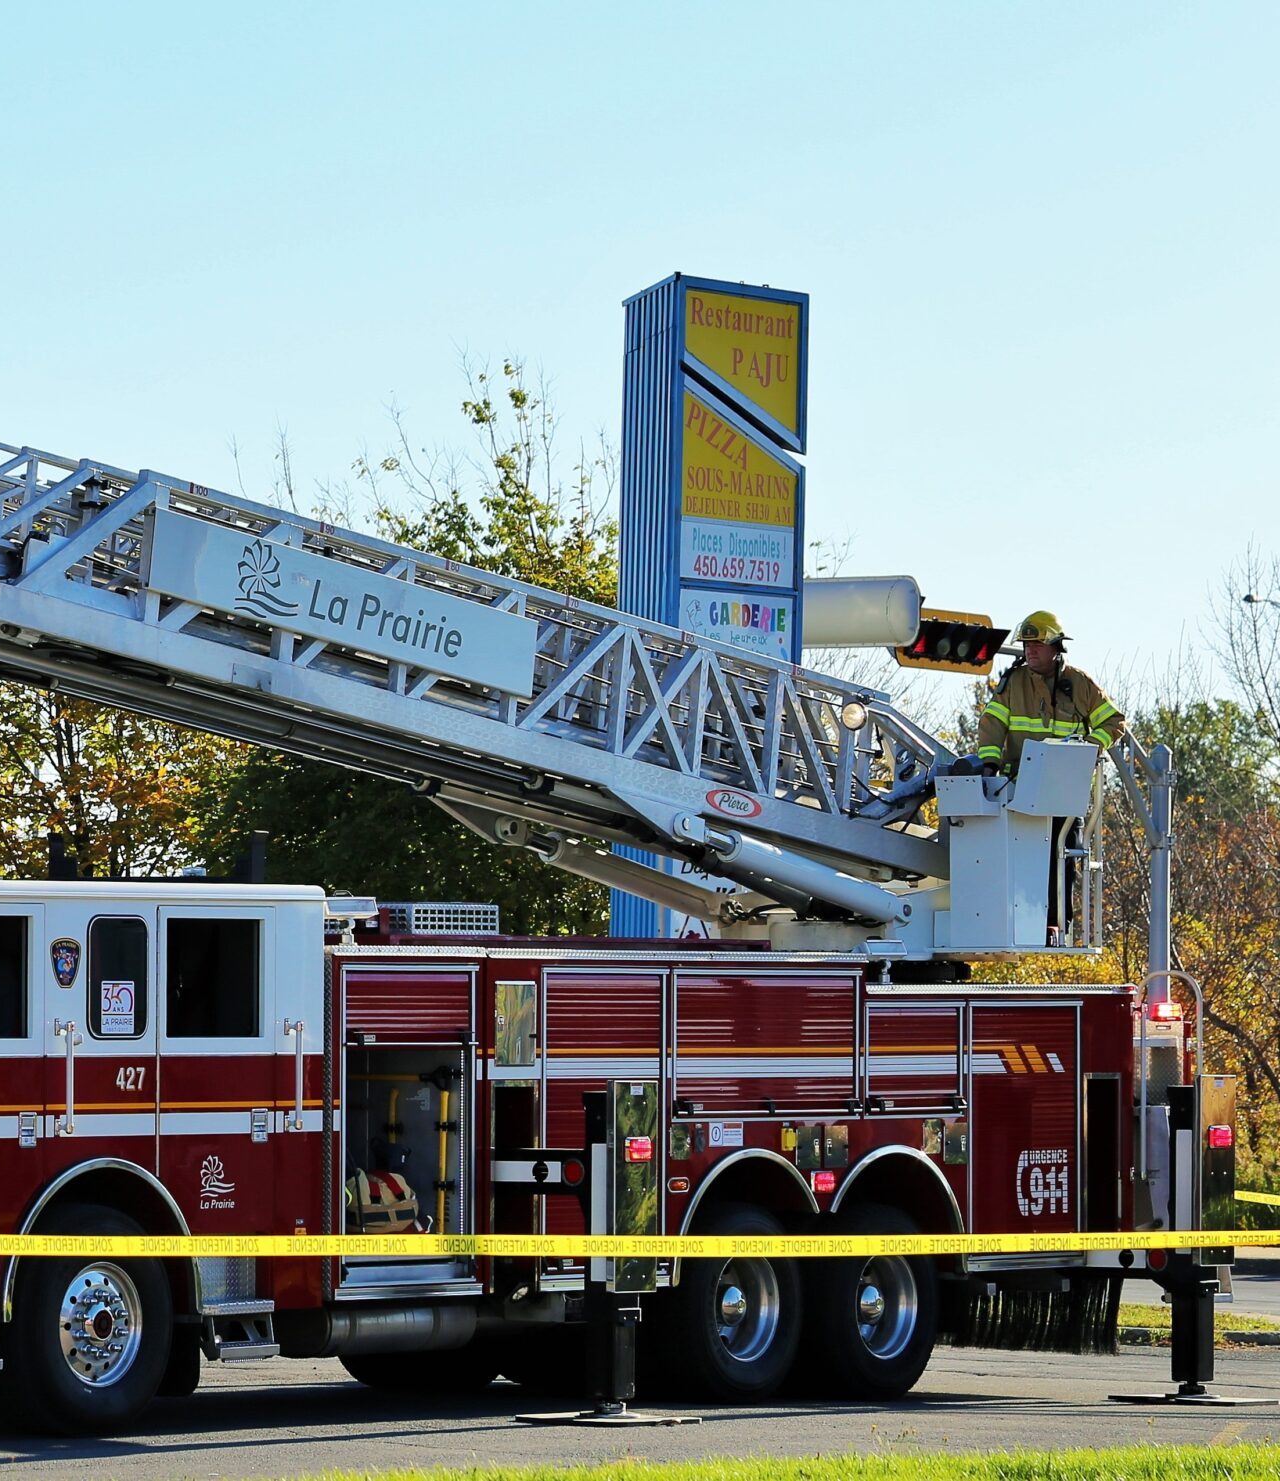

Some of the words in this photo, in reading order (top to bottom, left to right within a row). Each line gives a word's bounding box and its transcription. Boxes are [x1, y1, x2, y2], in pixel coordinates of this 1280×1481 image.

[691, 297, 794, 339] Restaurant
[732, 348, 790, 388] PAJU
[685, 401, 747, 472] PIZZA
[195, 485, 209, 497] 100
[687, 465, 790, 500] SOUS-MARINS
[685, 496, 740, 518] DEJEUNER
[746, 502, 770, 521] 5H30
[775, 506, 791, 524] AM
[324, 525, 335, 535] 90
[692, 528, 723, 553] Places
[729, 533, 780, 559] Disponibles
[450, 562, 460, 572] 80
[693, 555, 780, 582] 450.659.7519
[308, 578, 349, 625] La
[356, 592, 464, 658] Prairie
[709, 601, 786, 633] GARDERIE
[796, 669, 805, 677] 50
[718, 793, 749, 812] Pierce
[102, 984, 134, 1012] 350
[116, 1067, 145, 1091] 427
[1029, 1149, 1068, 1164] URGENCE
[200, 1200, 210, 1209] La
[210, 1199, 235, 1209] Prairie
[1030, 1166, 1068, 1216] 911
